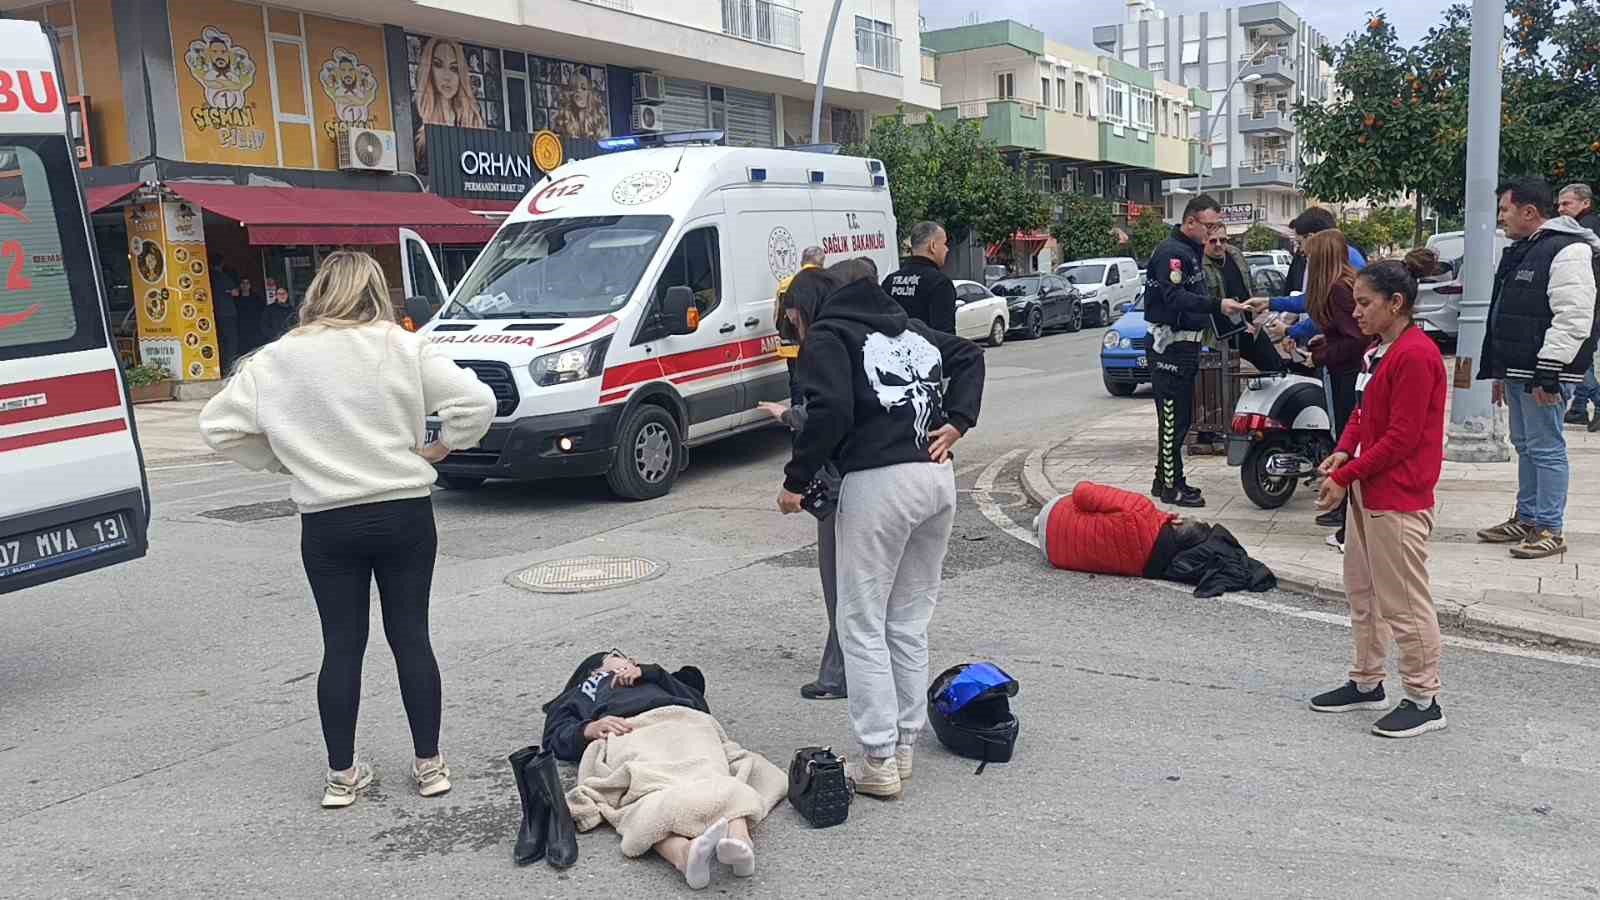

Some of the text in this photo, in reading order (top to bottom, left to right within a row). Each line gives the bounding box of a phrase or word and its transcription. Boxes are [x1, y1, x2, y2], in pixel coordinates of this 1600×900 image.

[461, 150, 531, 177] ORHAN
[545, 183, 584, 199] 112
[822, 233, 849, 254] SAĞLIK
[36, 529, 79, 557] MVA
[93, 519, 120, 542] 13
